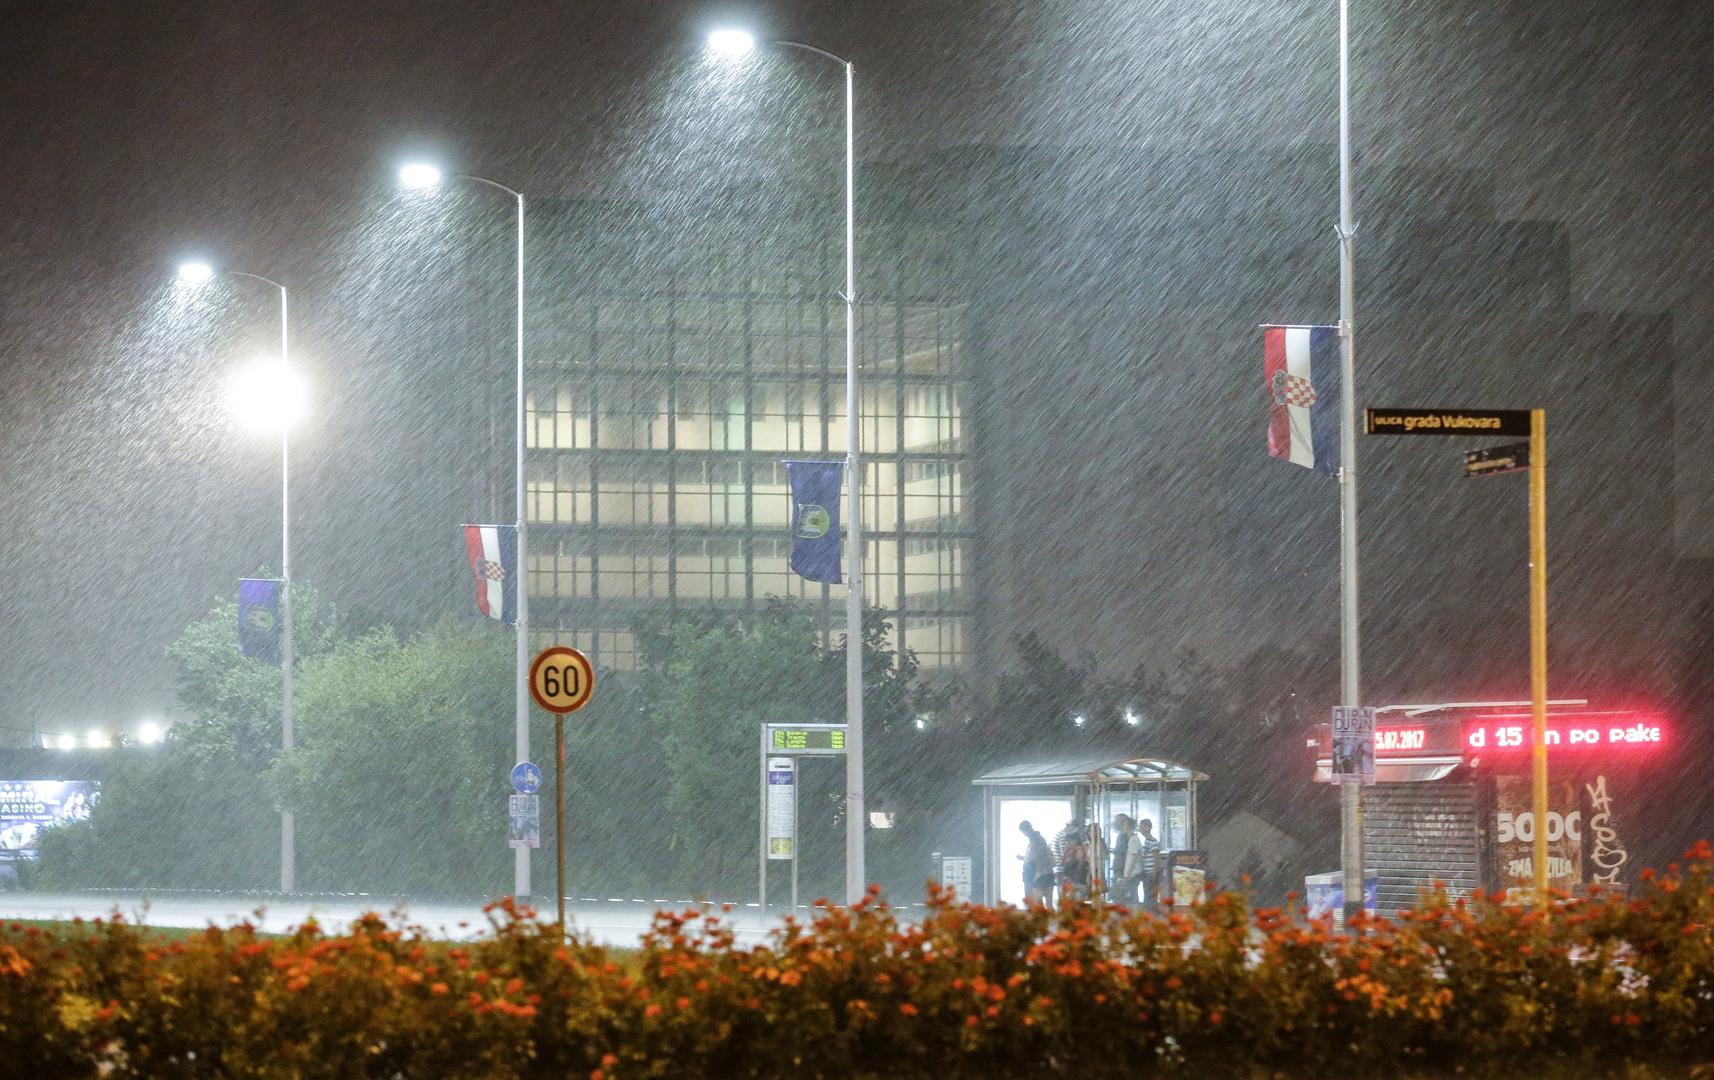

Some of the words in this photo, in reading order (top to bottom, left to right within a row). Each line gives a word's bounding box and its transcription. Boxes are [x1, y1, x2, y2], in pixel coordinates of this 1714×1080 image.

[1404, 414, 1441, 431] grada
[1441, 415, 1502, 429] Vukovara
[544, 665, 579, 698] 60
[1335, 719, 1372, 731] DURAN
[1495, 726, 1523, 747] 15
[1569, 728, 1600, 744] po
